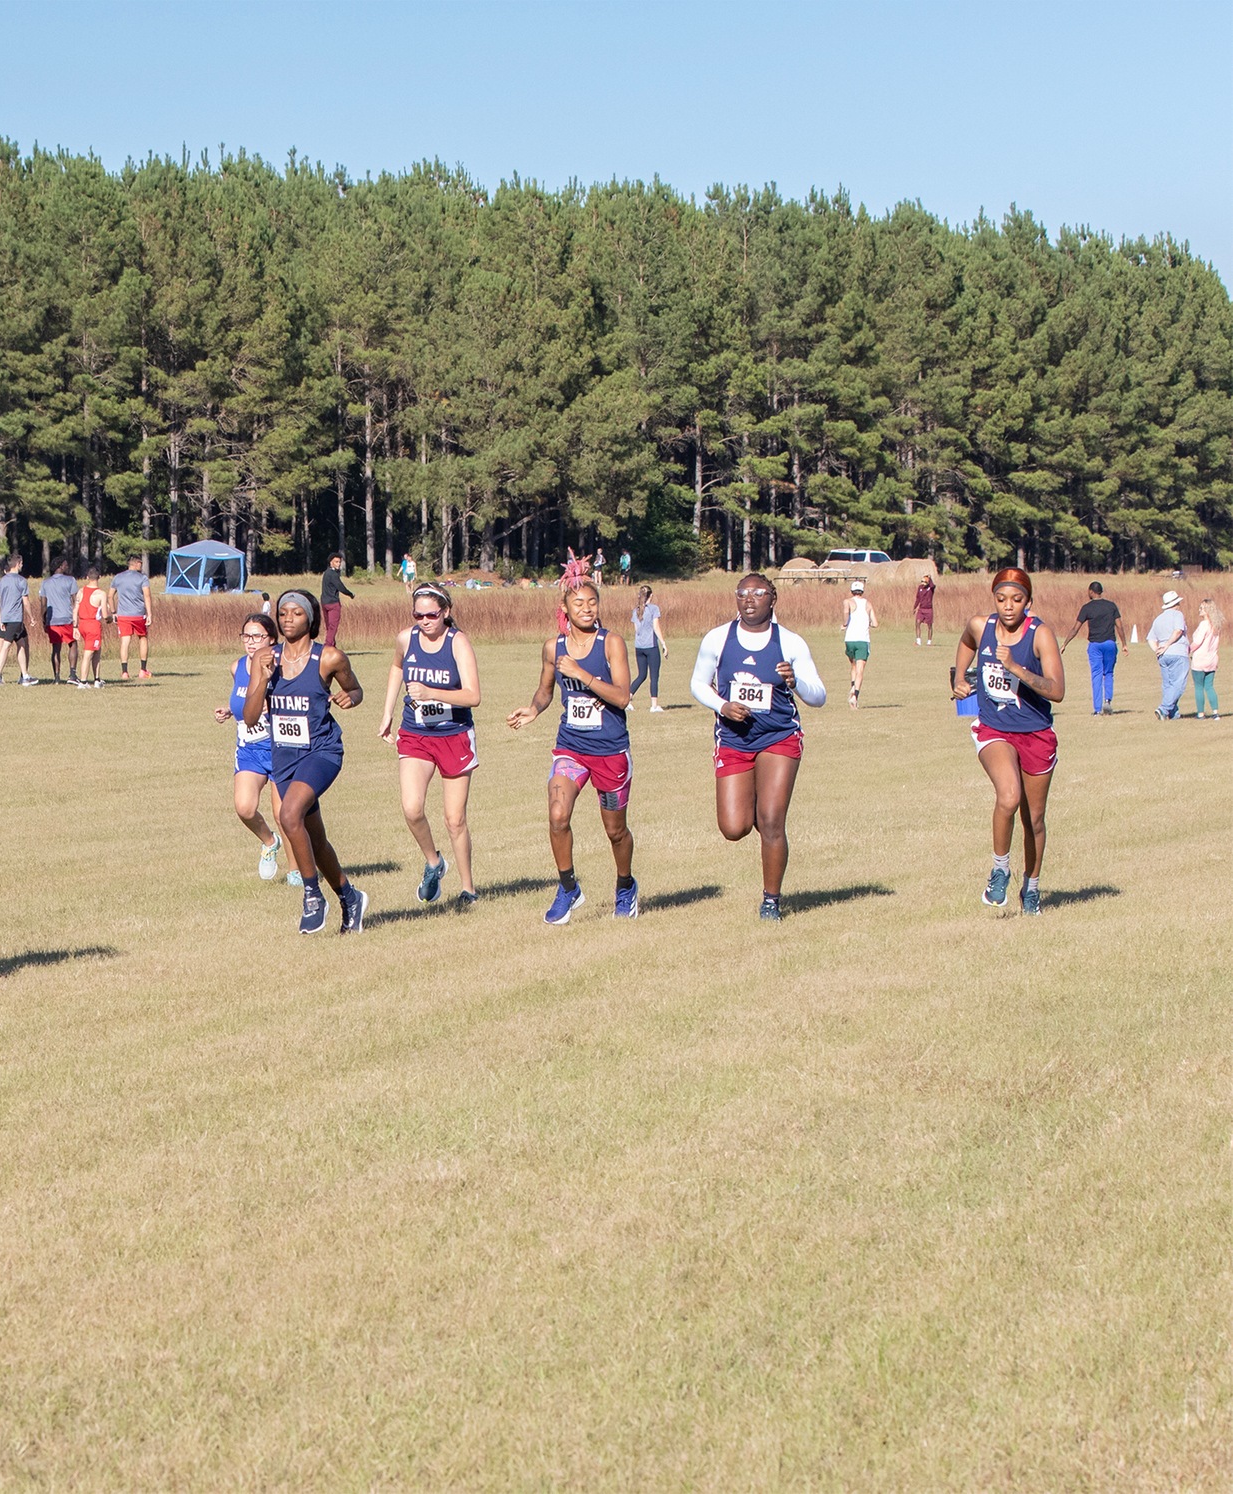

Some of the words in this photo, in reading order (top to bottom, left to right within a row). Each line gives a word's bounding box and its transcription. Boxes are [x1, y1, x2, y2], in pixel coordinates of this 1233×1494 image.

[408, 667, 450, 684] TITANS
[988, 675, 1012, 691] 365
[739, 688, 764, 702] 364
[269, 695, 309, 711] TITANS
[422, 703, 444, 716] 366
[572, 705, 593, 718] 367
[278, 723, 301, 736] 369
